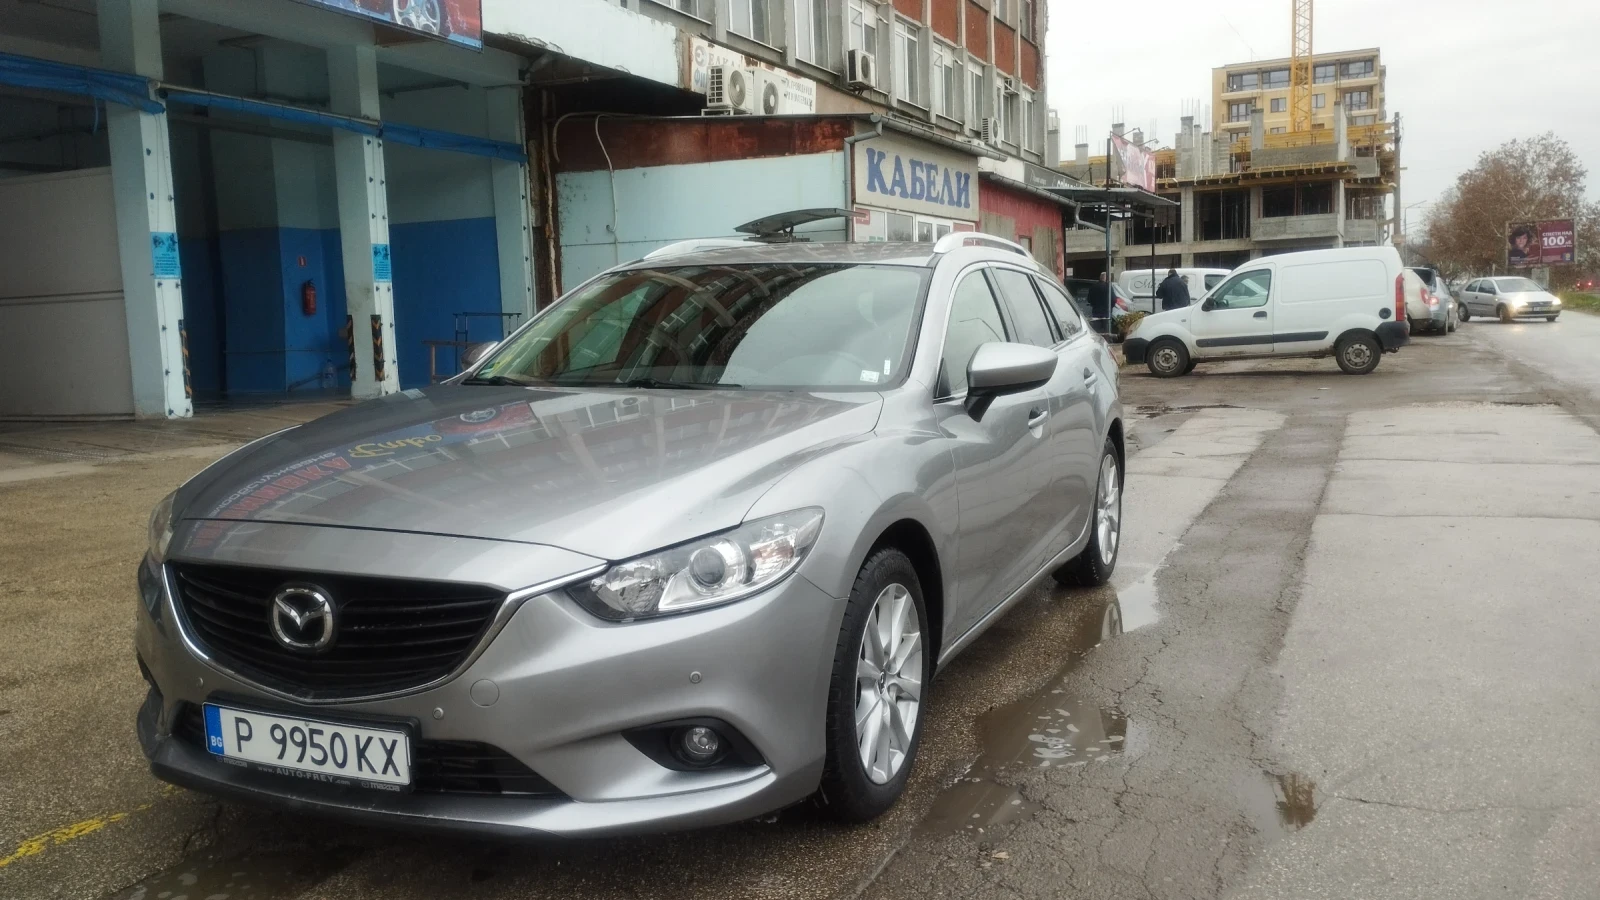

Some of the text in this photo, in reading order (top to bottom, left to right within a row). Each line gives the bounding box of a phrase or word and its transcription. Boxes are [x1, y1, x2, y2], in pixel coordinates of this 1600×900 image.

[866, 147, 970, 209] КАБЕЛИ
[210, 735, 223, 748] BG
[234, 716, 253, 753] P
